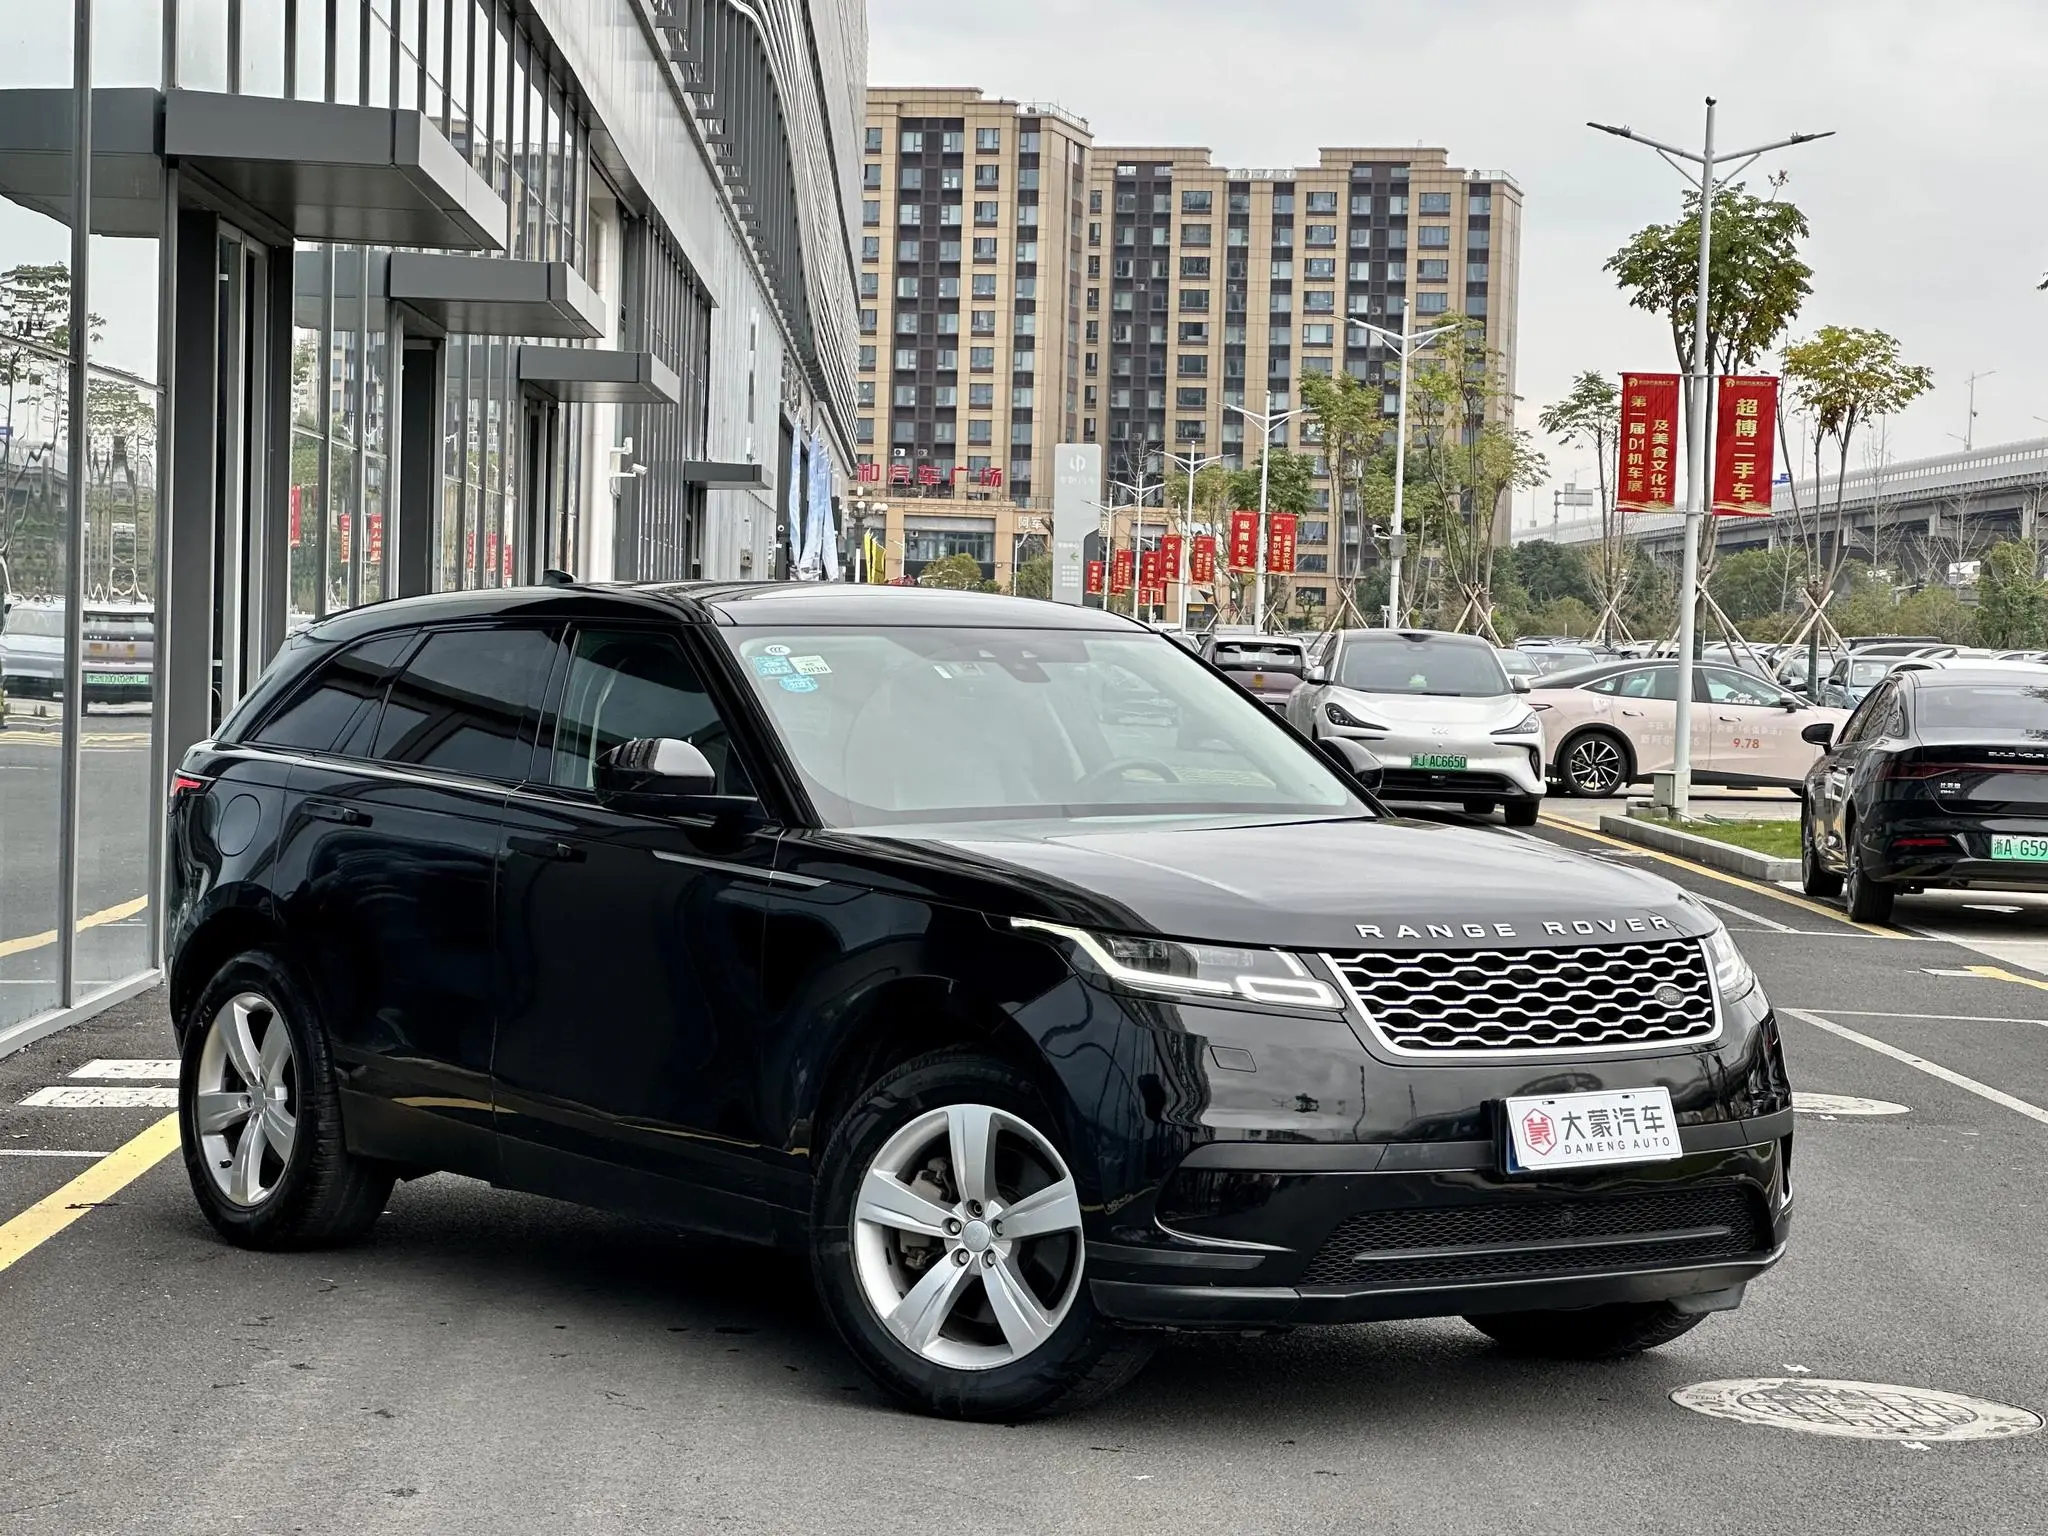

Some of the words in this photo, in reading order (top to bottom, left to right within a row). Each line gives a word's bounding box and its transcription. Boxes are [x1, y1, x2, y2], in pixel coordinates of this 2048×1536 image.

[1627, 395, 1647, 492] 第一届D1机车展
[1732, 398, 1758, 501] 超博二手车
[1650, 419, 1669, 499] 及美食文化节
[800, 665, 828, 674] 2020
[1733, 738, 1760, 749] 9.78
[1356, 923, 1517, 940] RANGE
[1544, 915, 1671, 936] ROVER
[1561, 1105, 1666, 1141] 大蒙汽车
[1564, 1140, 1626, 1155] DAMENG
[1633, 1136, 1671, 1150] AUTO
